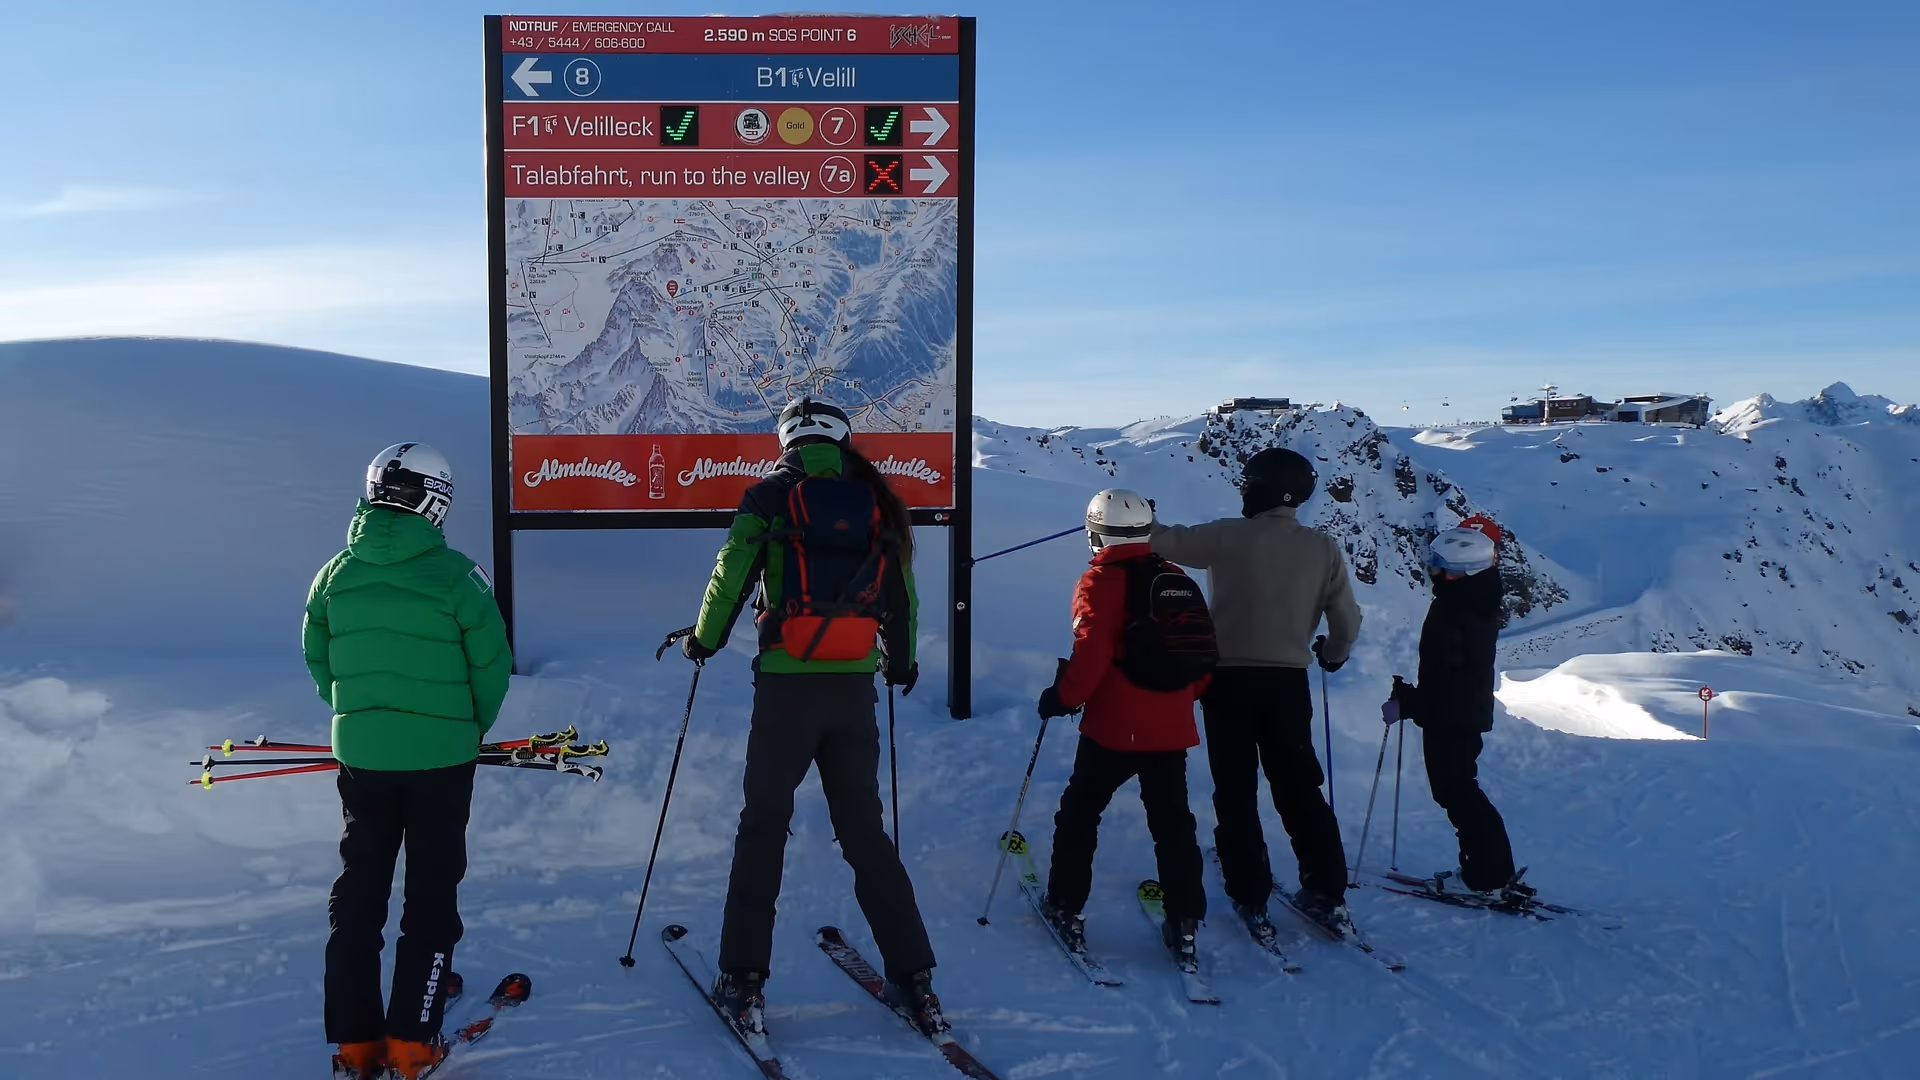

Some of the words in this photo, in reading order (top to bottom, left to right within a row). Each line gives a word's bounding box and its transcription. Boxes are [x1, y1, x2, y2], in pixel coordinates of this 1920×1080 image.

[509, 20, 559, 32] NOTRUF
[572, 21, 644, 33] EMERGENCY
[646, 22, 675, 33] CALL
[704, 28, 748, 42] 2.590
[752, 32, 765, 42] m
[768, 28, 797, 42] SOS
[801, 28, 844, 42] POINT
[846, 28, 857, 42] 6
[509, 36, 533, 48] +43
[548, 37, 580, 48] 5444
[594, 37, 646, 49] 606-600
[575, 67, 590, 85] 8
[757, 66, 786, 88] B1
[805, 66, 856, 88] Velill
[512, 115, 539, 136] F1
[564, 115, 654, 137] Velilleck
[786, 121, 805, 130] Gold
[831, 117, 845, 135] 7
[510, 164, 633, 188] Talabfahrt,
[640, 170, 676, 186] run
[682, 168, 706, 186] to
[711, 165, 747, 185] the
[752, 165, 812, 191] valley
[825, 165, 851, 184] 7a
[523, 456, 637, 488] Almdudler
[677, 455, 774, 487] Almdudl
[870, 454, 941, 485] dudler
[1159, 589, 1193, 597] ATOMIC
[419, 952, 445, 1023] Kappa
